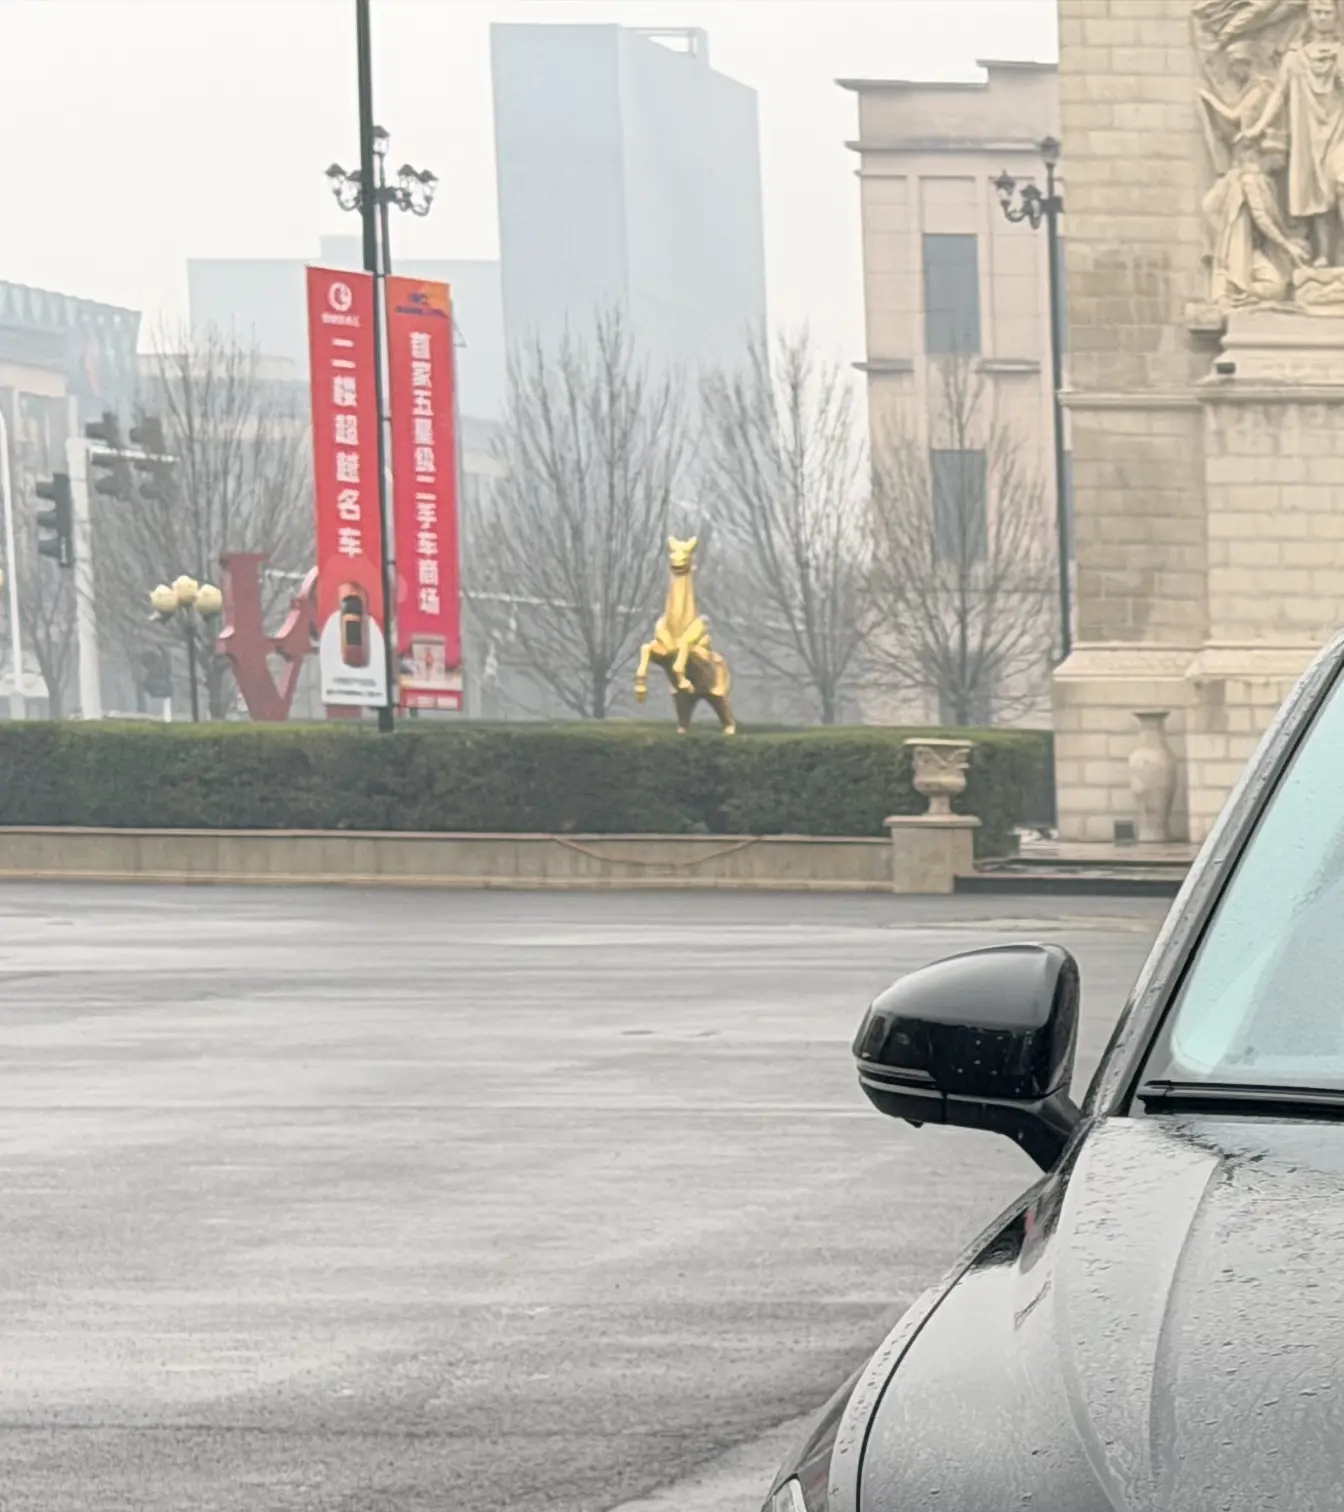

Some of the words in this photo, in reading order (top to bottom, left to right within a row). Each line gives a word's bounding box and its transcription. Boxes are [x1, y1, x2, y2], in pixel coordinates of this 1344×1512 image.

[331, 338, 362, 557] 二楼超越名车
